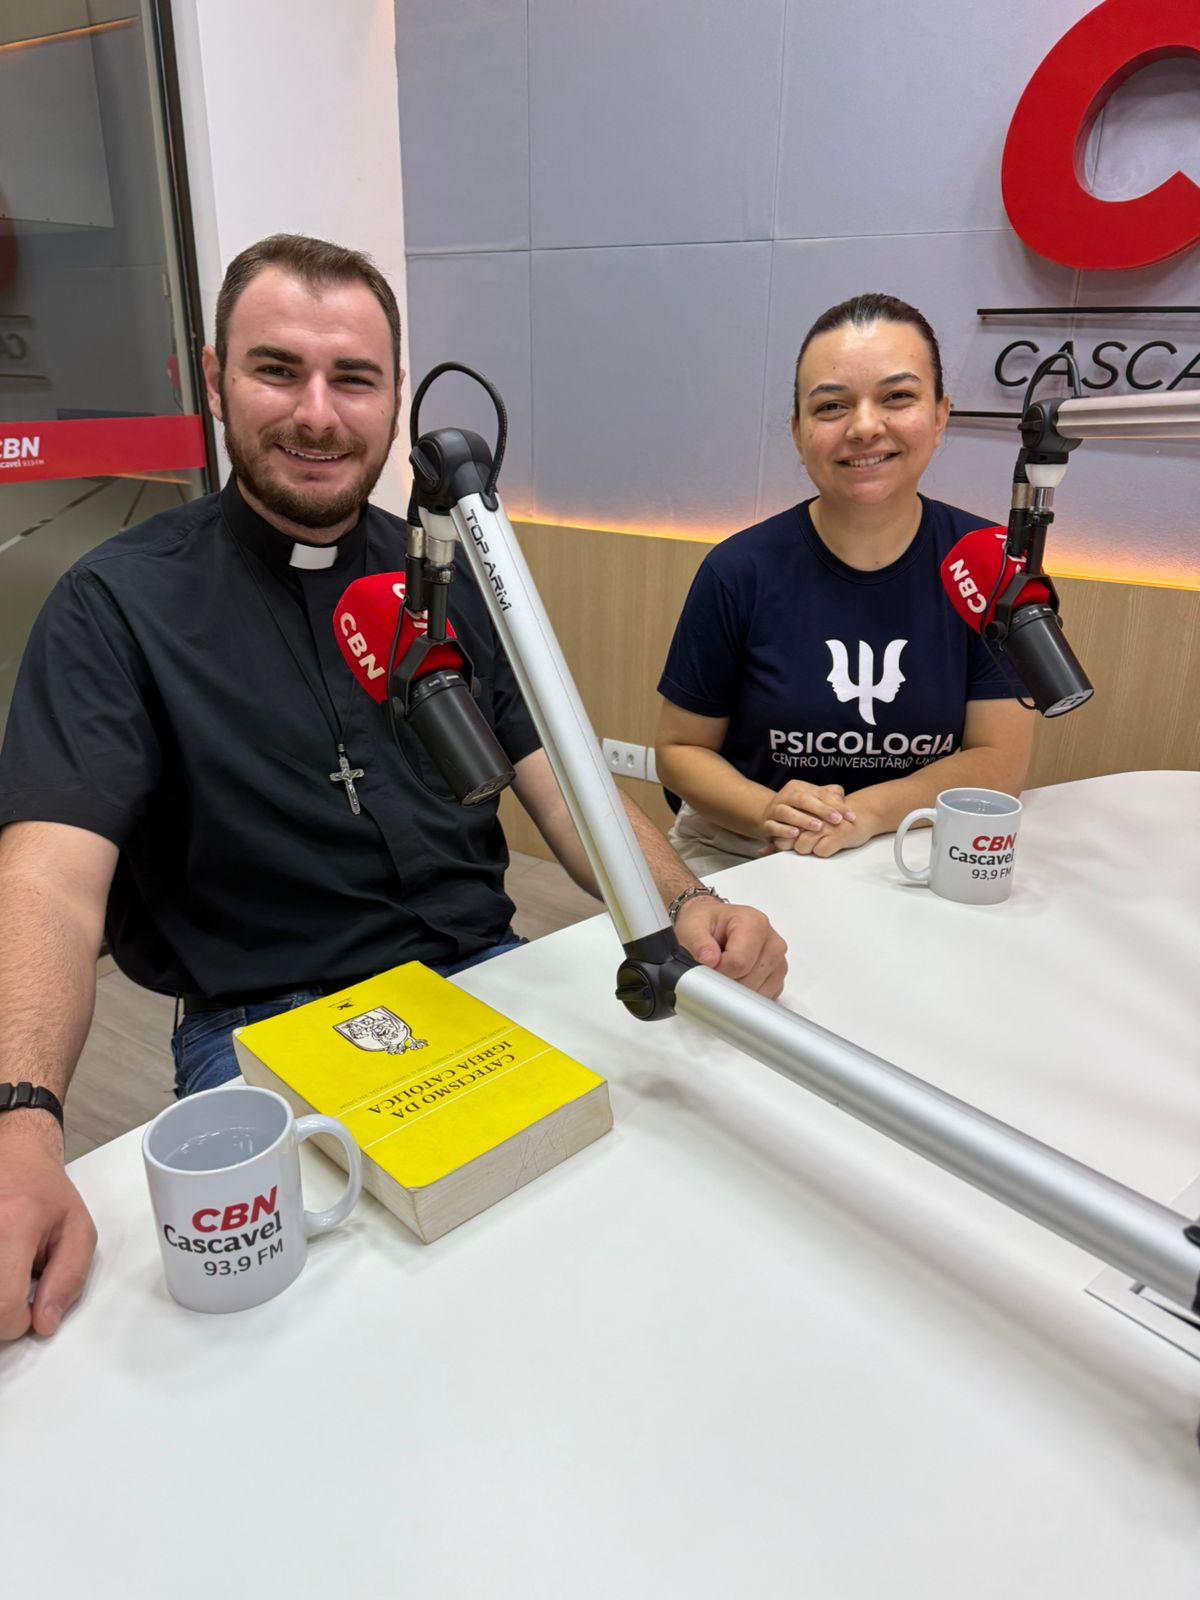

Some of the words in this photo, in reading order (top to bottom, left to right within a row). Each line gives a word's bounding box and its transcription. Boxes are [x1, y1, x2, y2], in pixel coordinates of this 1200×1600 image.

[0, 436, 40, 458] BN
[466, 508, 489, 554] TOP
[949, 559, 987, 614] CBN
[340, 612, 386, 681] CBN
[769, 729, 954, 755] PSICOLOGIA
[772, 752, 819, 768] CENTRO
[821, 755, 913, 769] UNIVERSITÁRIO
[948, 845, 1015, 866] Cascavel
[972, 832, 1017, 852] CBN
[971, 869, 998, 880] 93,9
[457, 1040, 512, 1070] IGREJA
[367, 1069, 456, 1115] CATÓLICA
[421, 1053, 516, 1105] CATECISMO
[391, 1103, 421, 1119] DA
[192, 1185, 278, 1233] CBN
[164, 1210, 283, 1254] Cascavel
[203, 1255, 251, 1276] 93,9
[257, 1238, 284, 1266] FM
